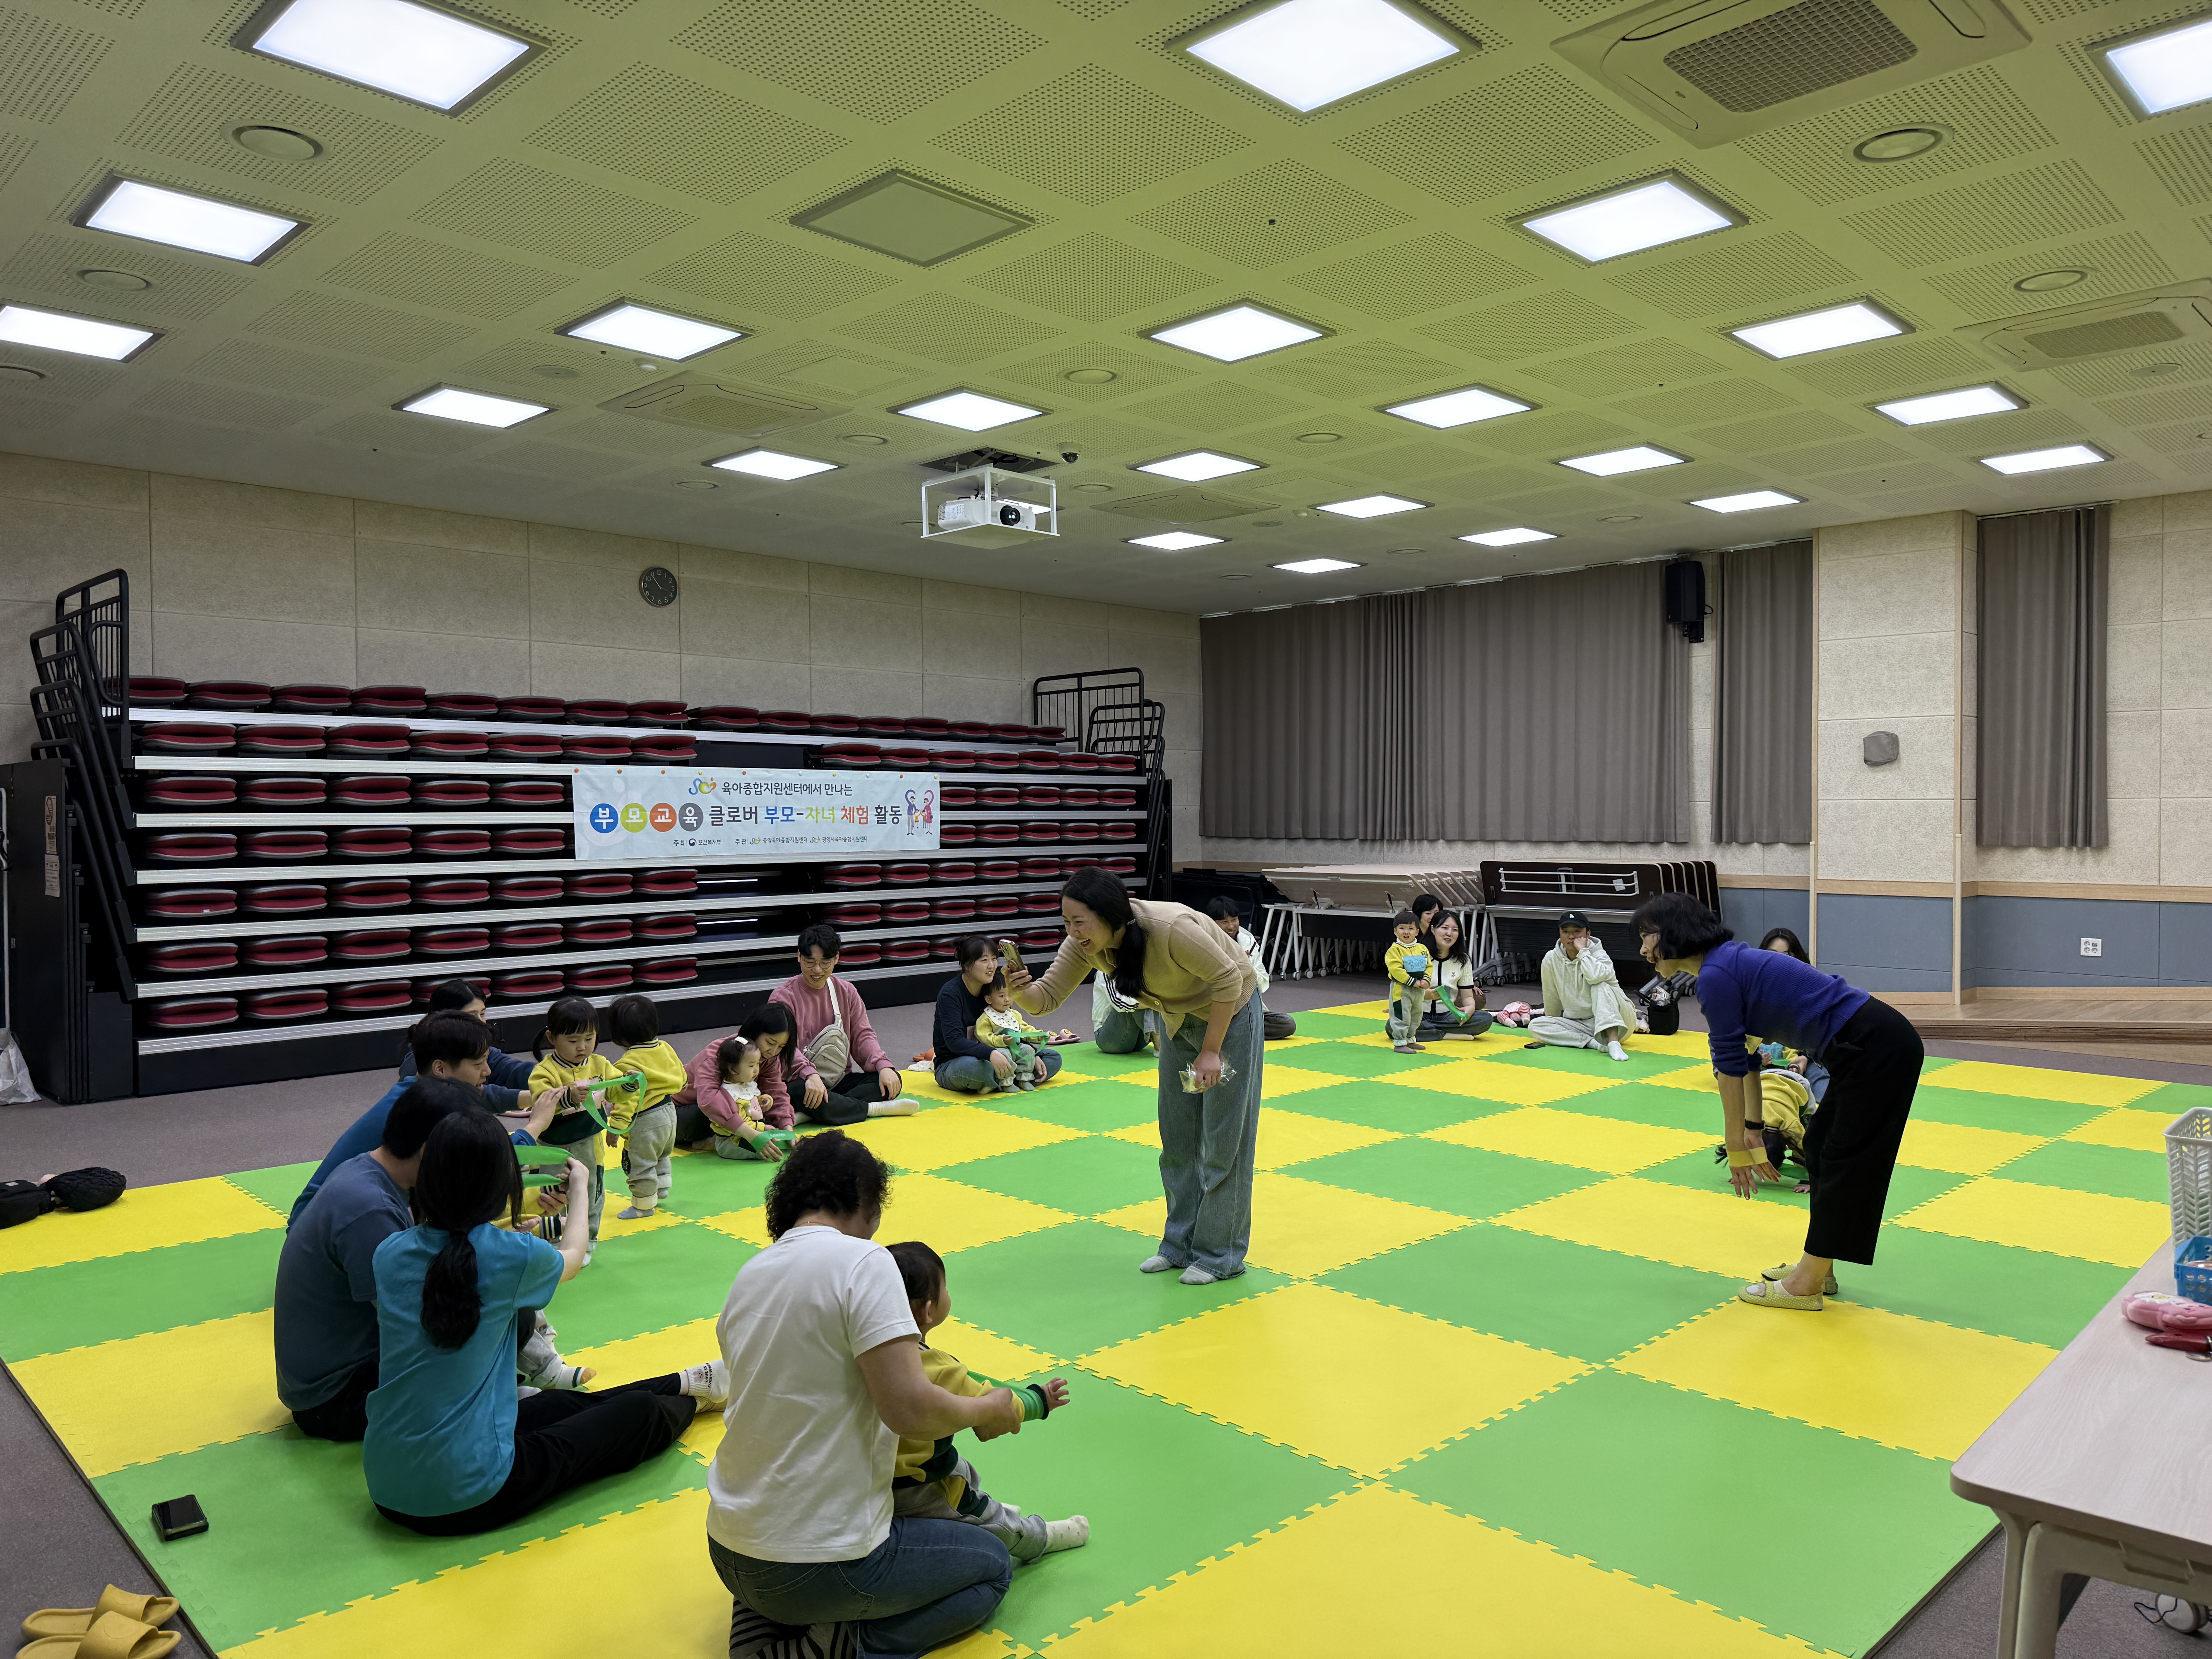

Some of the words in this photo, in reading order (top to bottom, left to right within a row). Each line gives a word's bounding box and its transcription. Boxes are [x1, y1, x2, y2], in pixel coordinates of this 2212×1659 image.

[721, 781, 822, 795] 육아종합지원센터에서
[824, 783, 853, 796] 만나는
[709, 805, 758, 826] 클로버
[764, 805, 836, 824] 부모-자녀
[840, 805, 869, 825] 체험
[874, 804, 902, 825] 활동
